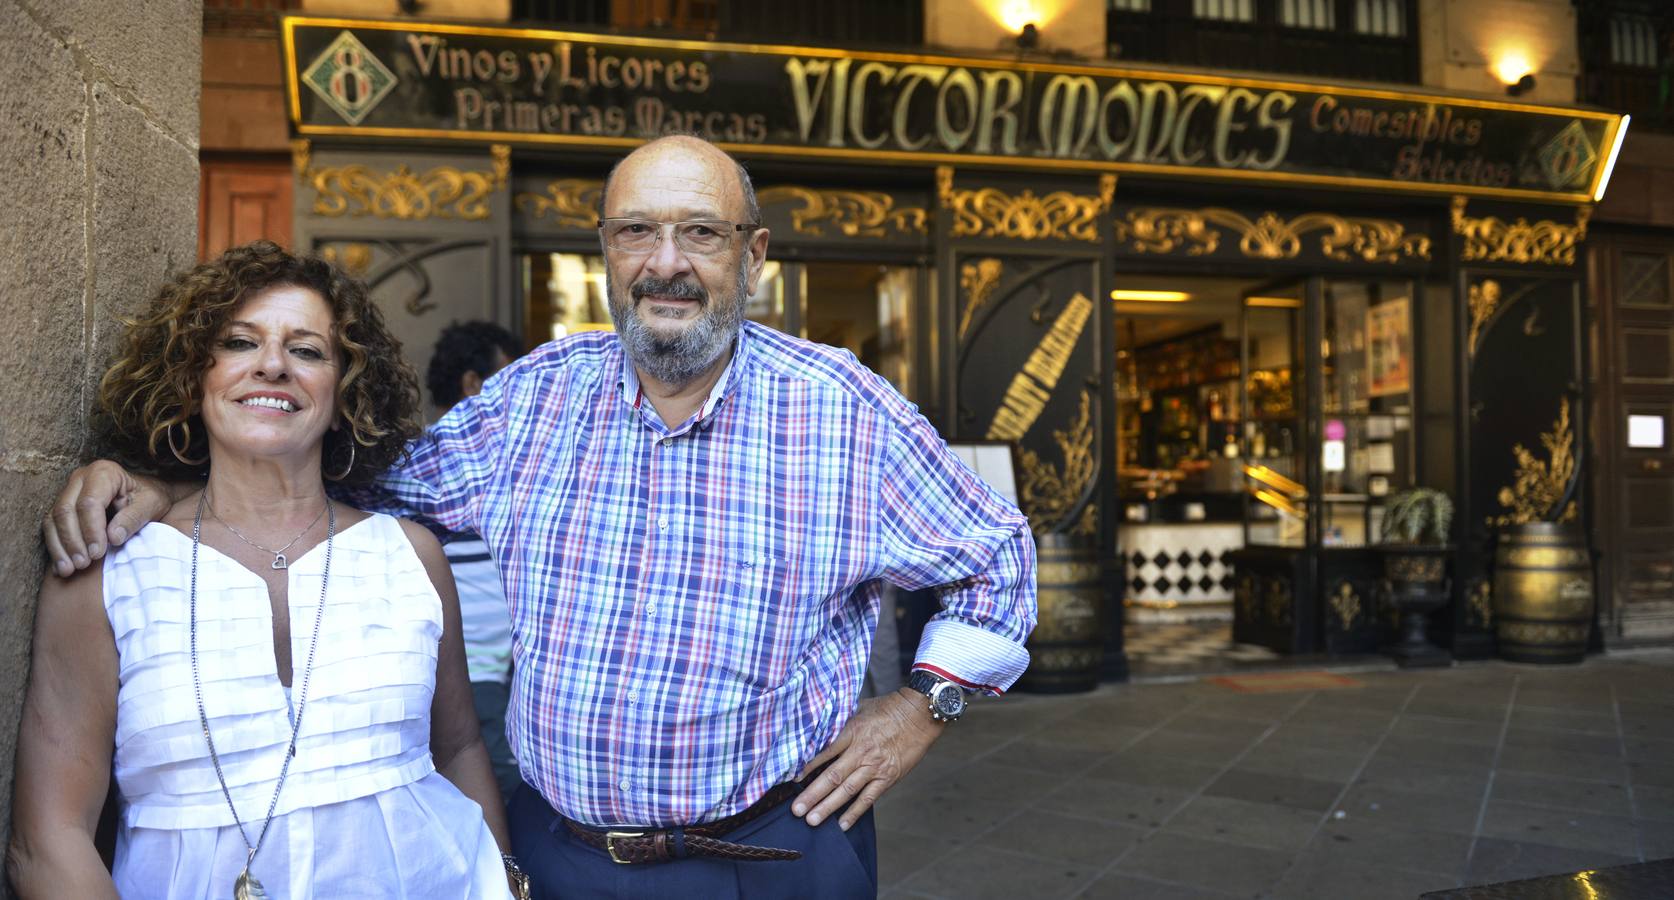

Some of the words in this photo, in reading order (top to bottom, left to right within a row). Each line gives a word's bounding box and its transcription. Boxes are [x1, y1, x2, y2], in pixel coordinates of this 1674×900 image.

[330, 49, 371, 106] 8
[407, 34, 520, 82] Vinos
[532, 55, 553, 95] y
[553, 42, 711, 93] Licores
[456, 88, 627, 137] Primeras
[634, 96, 767, 143] Marcas
[785, 57, 1024, 154] VICTOR
[1035, 73, 1297, 170] MONTES
[1310, 94, 1483, 145] Comestibles
[1392, 145, 1512, 187] Selectos
